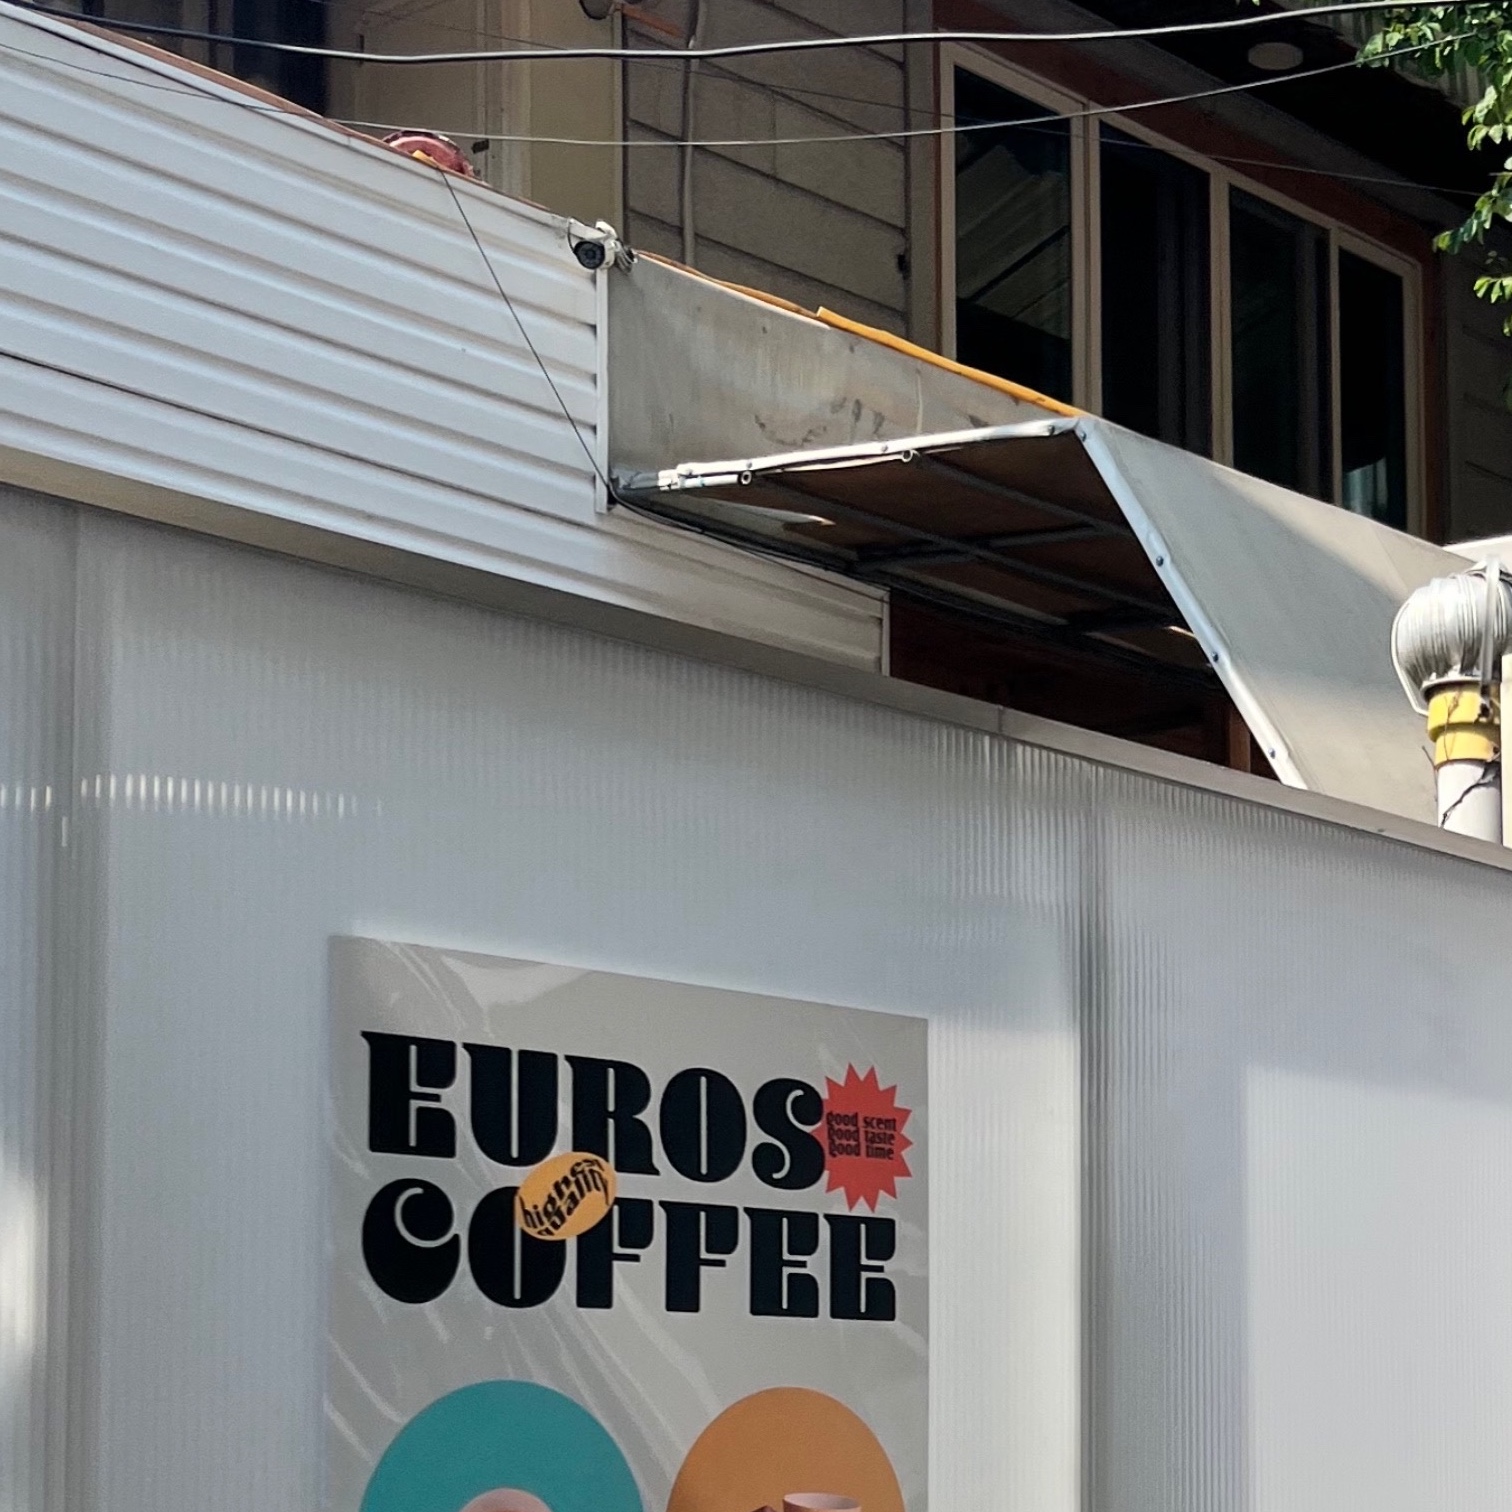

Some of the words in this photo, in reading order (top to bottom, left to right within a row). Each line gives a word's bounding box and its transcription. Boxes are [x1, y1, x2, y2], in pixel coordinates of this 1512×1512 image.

[361, 1030, 825, 1191] EUROS
[826, 1110, 859, 1128] good
[827, 1125, 860, 1143] good
[865, 1130, 895, 1146] taste
[829, 1140, 861, 1158] good
[866, 1144, 894, 1161] time
[361, 1178, 897, 1322] COFFEE
